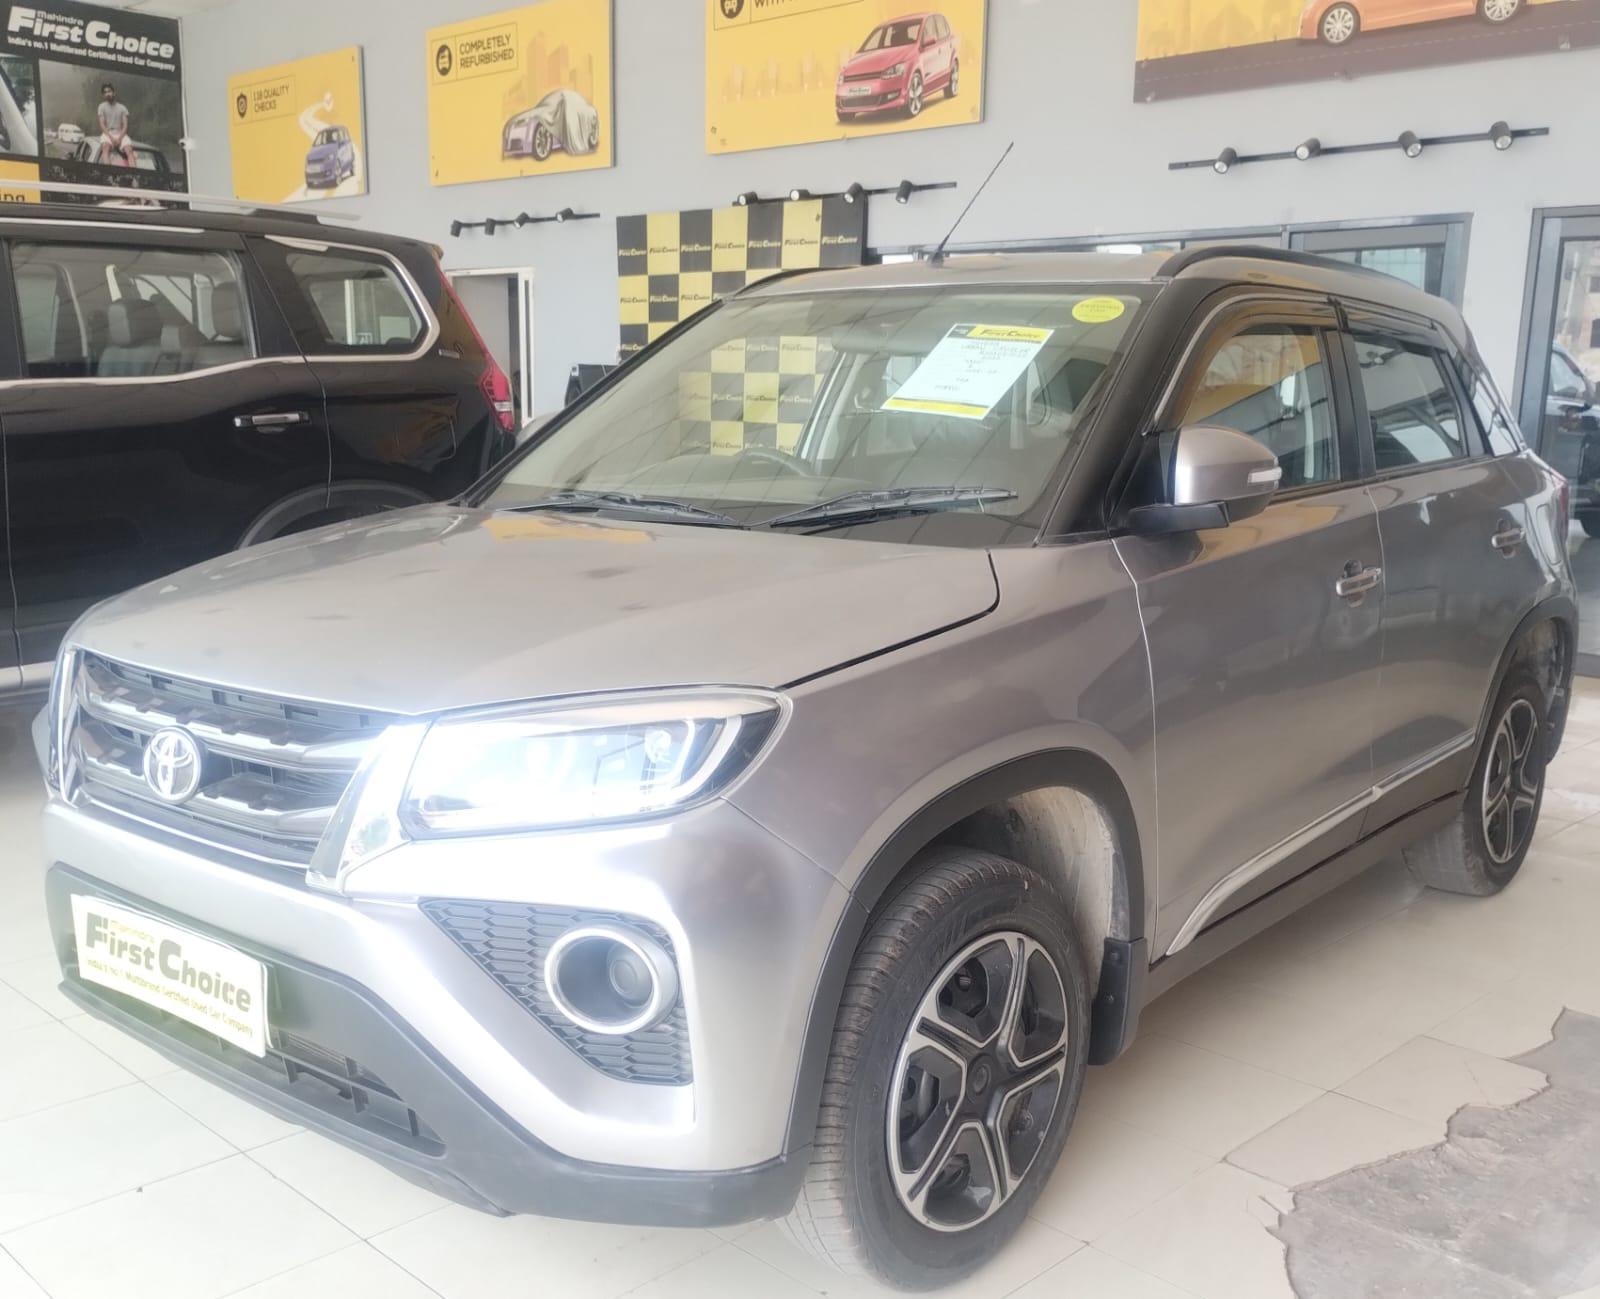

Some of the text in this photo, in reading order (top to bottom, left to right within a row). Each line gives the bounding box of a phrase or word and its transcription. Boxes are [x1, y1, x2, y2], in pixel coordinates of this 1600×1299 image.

[8, 6, 174, 58] First Choice
[8, 36, 32, 47] India's
[50, 42, 87, 57] Multibrand
[88, 49, 116, 61] Certified
[117, 54, 133, 64] Used
[134, 57, 145, 66] Car
[146, 59, 175, 72] Company
[460, 33, 511, 55] COMPLETELY
[460, 48, 514, 68] REFURBISHED
[263, 83, 290, 99] QUALITY
[254, 100, 277, 112] CHECKS
[86, 912, 251, 1013] First Choice
